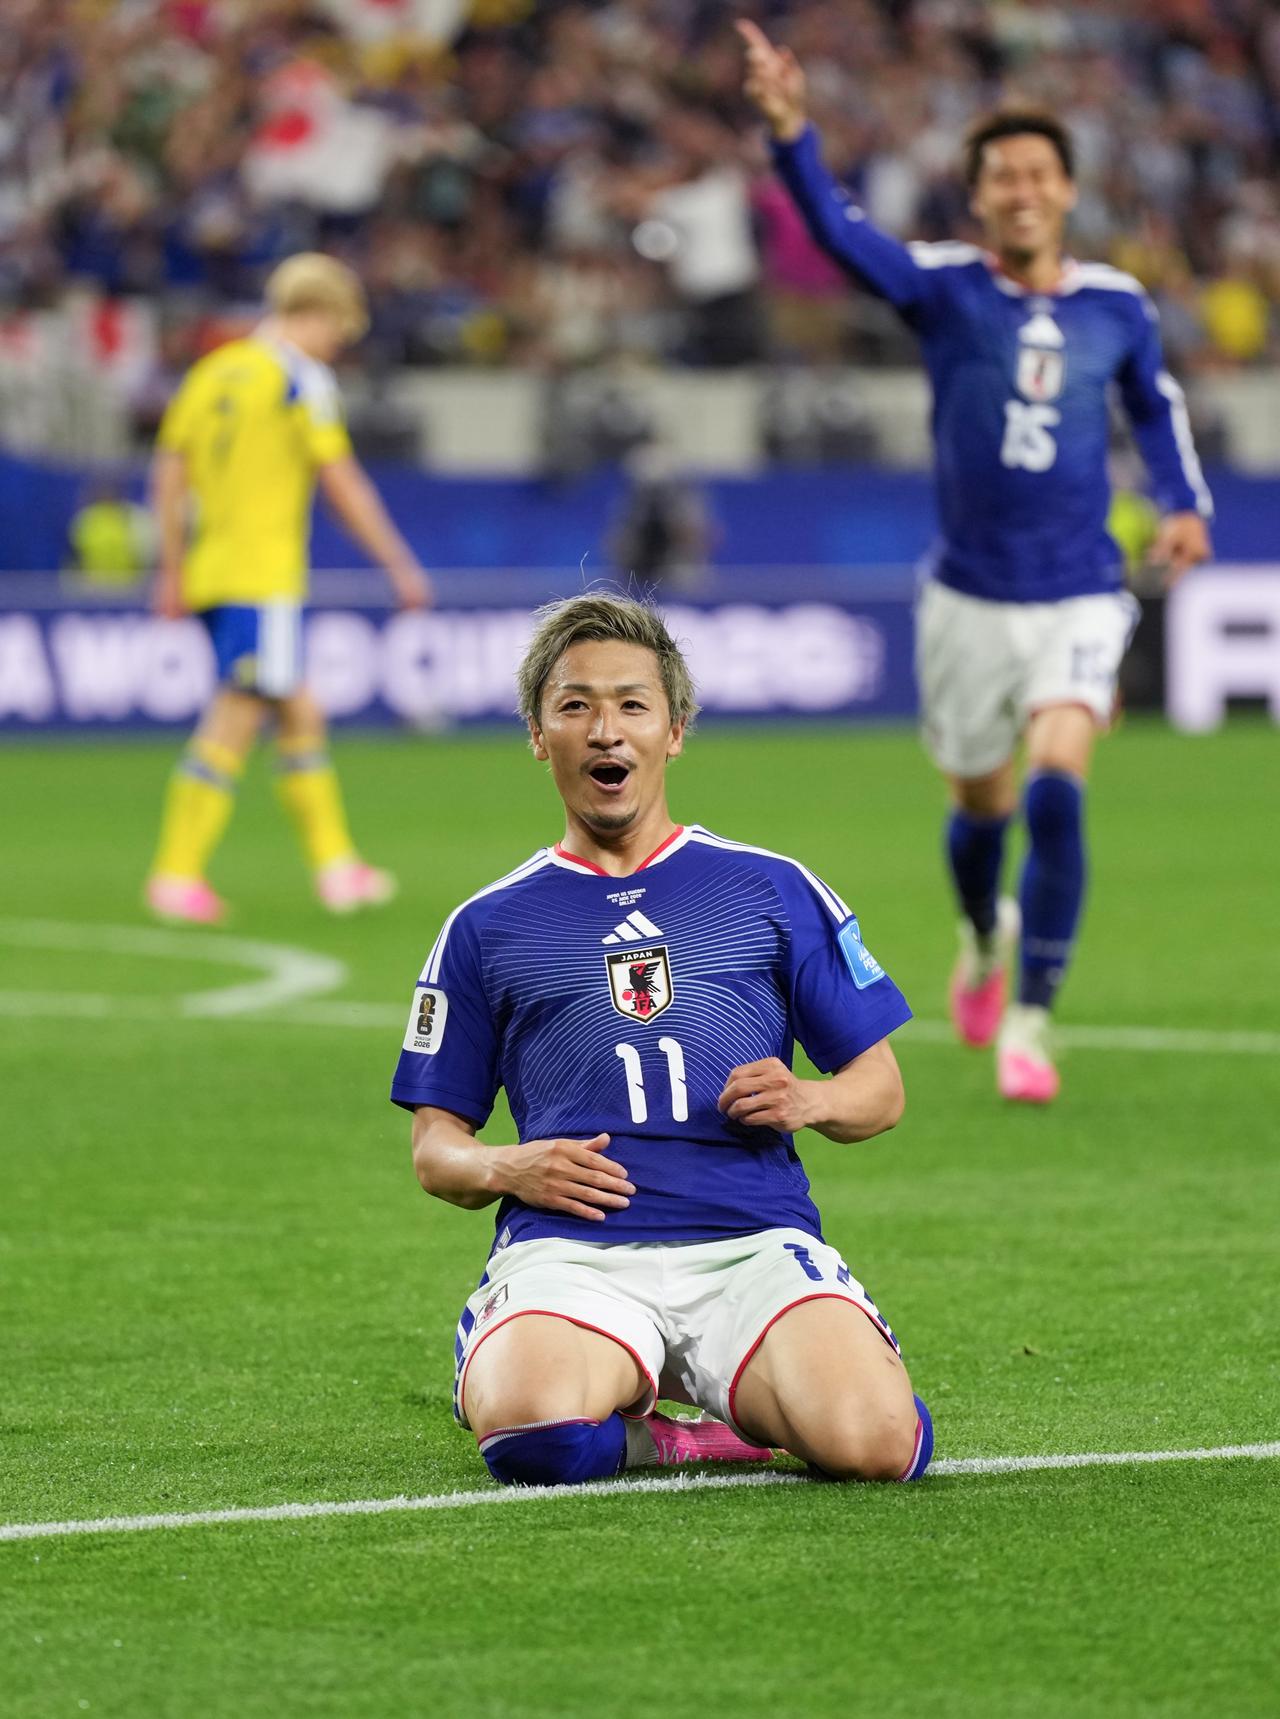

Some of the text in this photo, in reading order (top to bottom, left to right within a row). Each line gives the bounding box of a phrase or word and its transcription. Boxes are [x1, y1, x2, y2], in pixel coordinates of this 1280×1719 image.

[1000, 398, 1061, 473] 15
[50, 612, 379, 721] WOD
[621, 951, 653, 962] JAPAN
[631, 998, 657, 1012] JFA
[413, 1040, 431, 1049] 2026
[615, 1037, 688, 1124] 11
